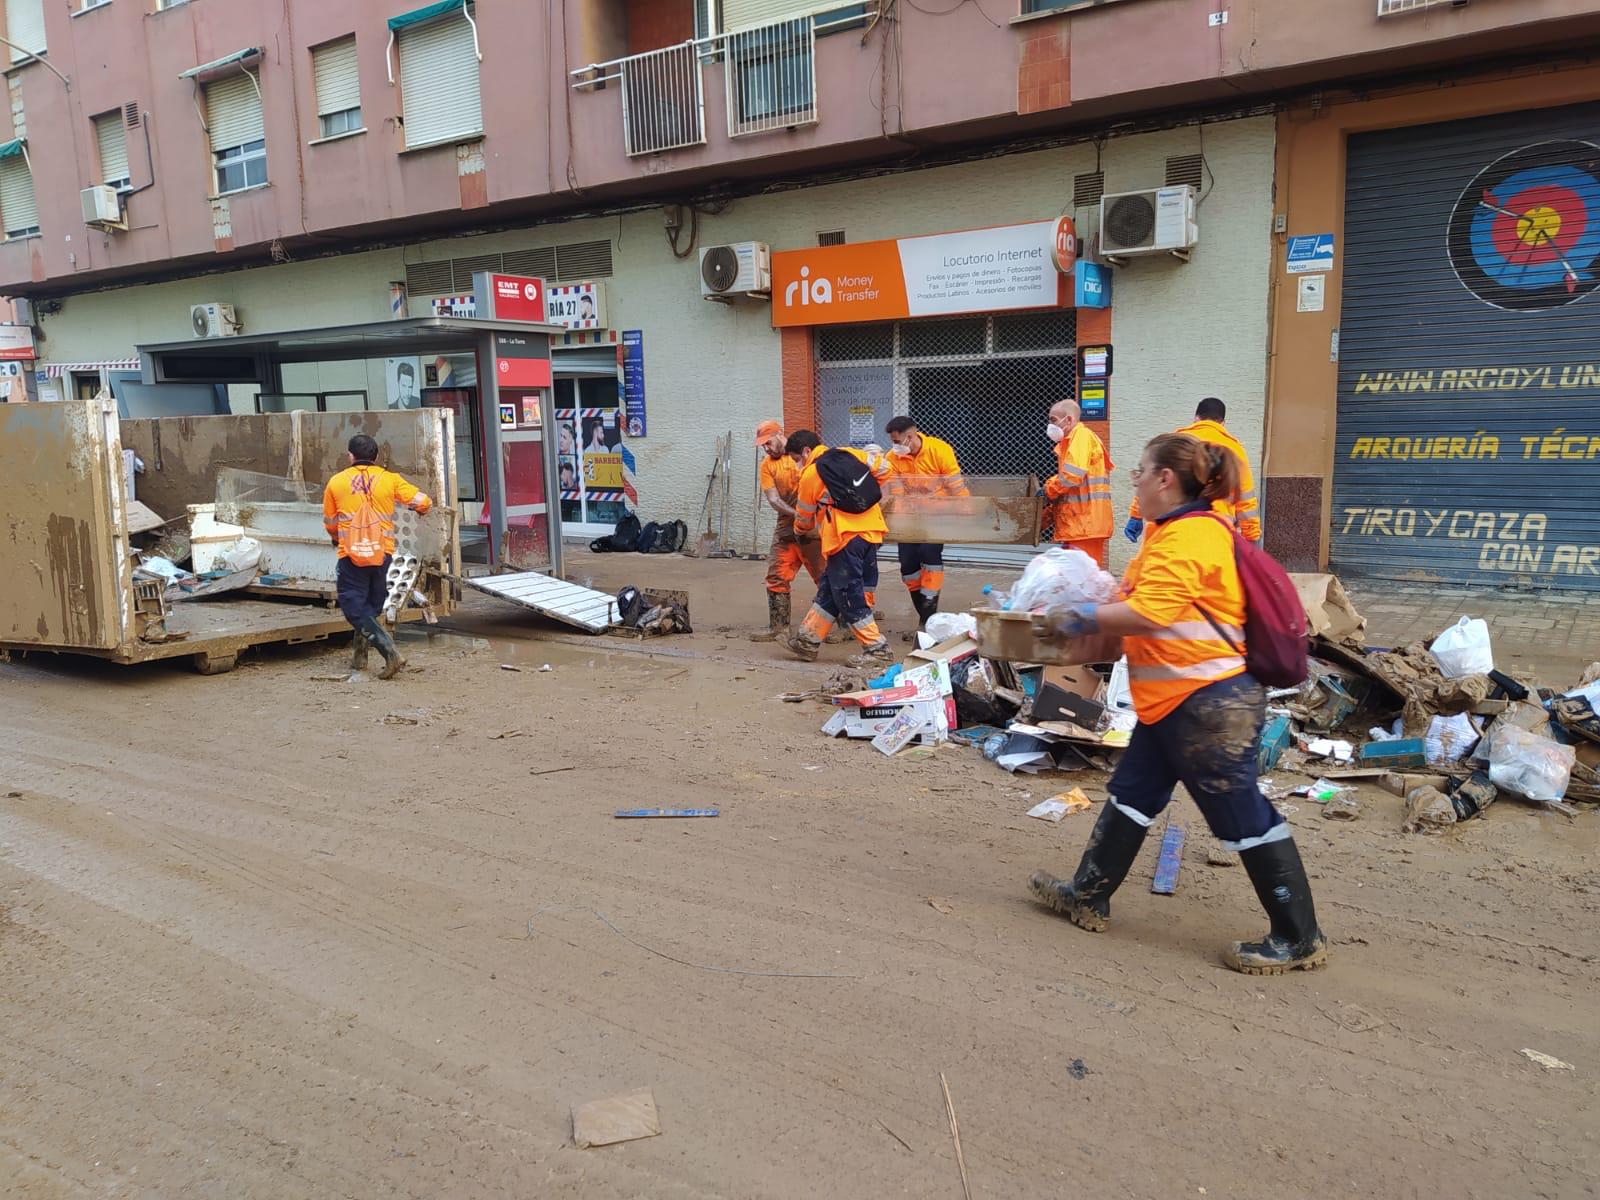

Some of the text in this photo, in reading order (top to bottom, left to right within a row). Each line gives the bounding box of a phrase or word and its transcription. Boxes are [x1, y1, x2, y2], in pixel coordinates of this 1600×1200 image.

[1057, 223, 1075, 253] ria
[943, 252, 994, 267] Locutorio
[997, 247, 1043, 262] Internet
[951, 272, 970, 280] pagos
[981, 269, 1001, 277] dinero
[1007, 265, 1043, 274] Fotocopias
[1011, 274, 1042, 283] Recargas
[498, 281, 519, 290] EMT
[785, 265, 833, 307] ria
[837, 275, 874, 288] Money
[837, 288, 880, 302] Transfer
[566, 301, 577, 316] 27
[1350, 429, 1499, 461] ARQUERÍA
[1448, 510, 1547, 540] CAZA
[1478, 543, 1600, 576] CON AR
